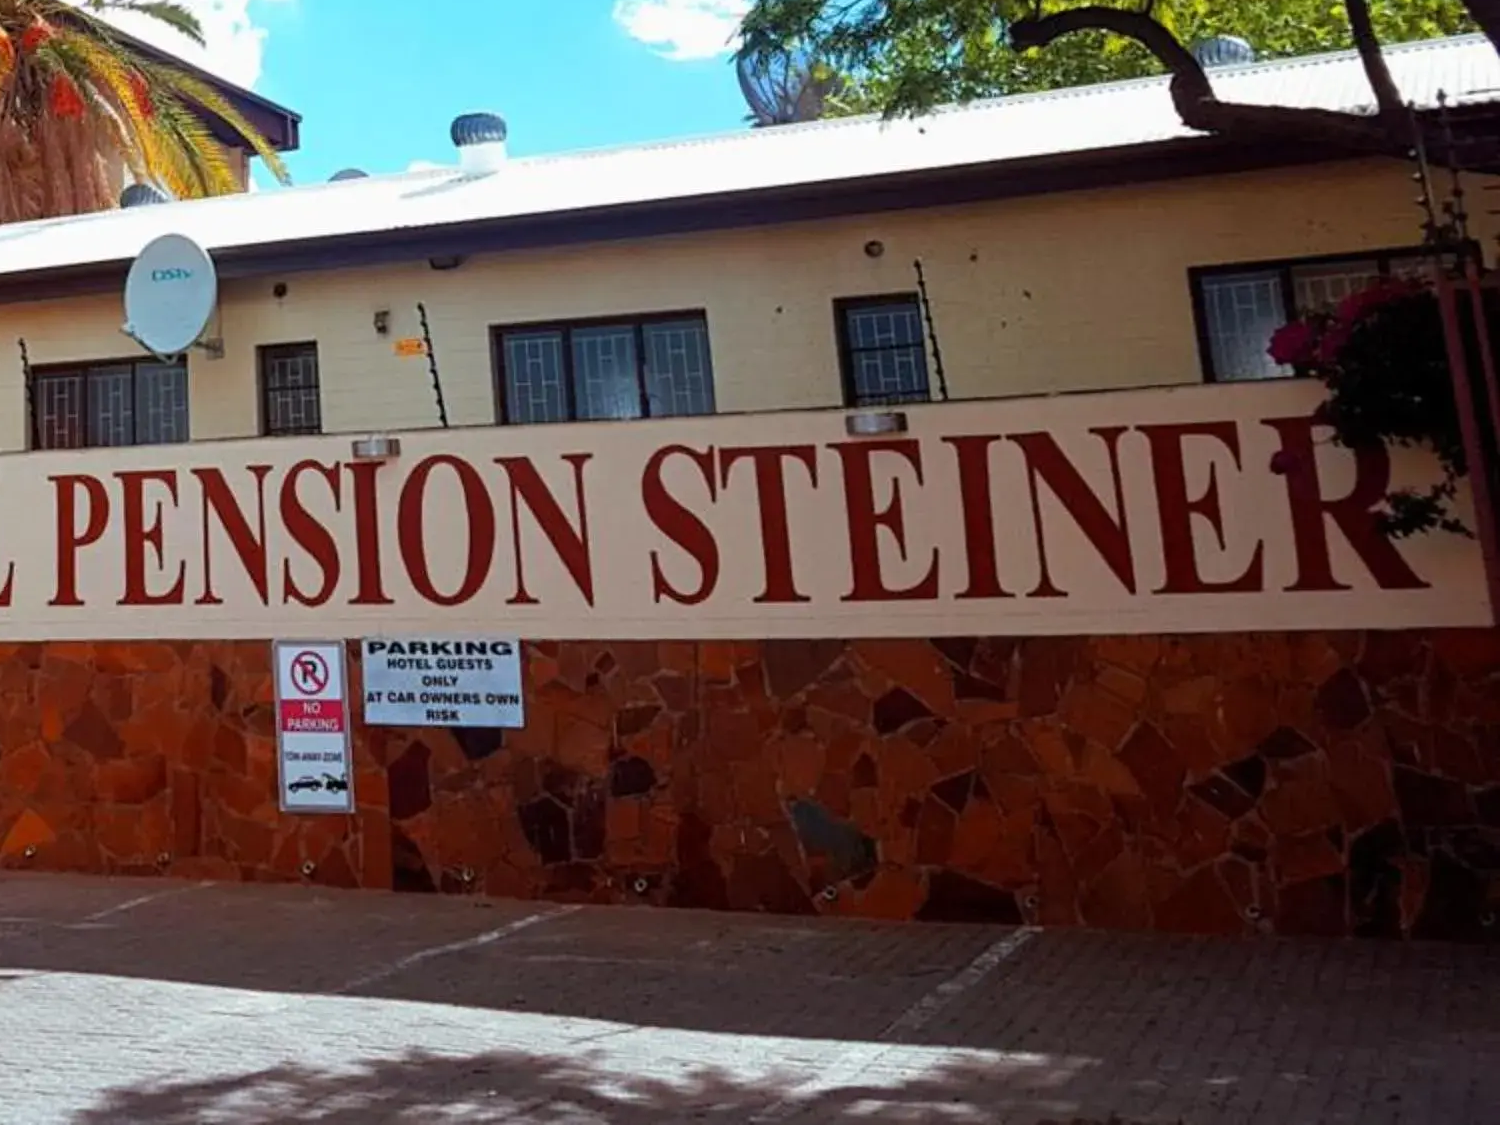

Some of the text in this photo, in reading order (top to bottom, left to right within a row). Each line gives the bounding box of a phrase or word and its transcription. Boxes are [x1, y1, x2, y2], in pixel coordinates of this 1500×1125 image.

[46, 451, 595, 608] PENSION
[639, 415, 1433, 607] STEINER
[367, 640, 513, 656] PARKING
[387, 658, 494, 671] HOTEL GUESTS
[421, 675, 459, 688] ONLY
[367, 692, 520, 706] AT CAR OWNERS OWN
[303, 701, 322, 715] NO
[425, 709, 460, 722] RISK
[287, 717, 339, 732] PARKING
